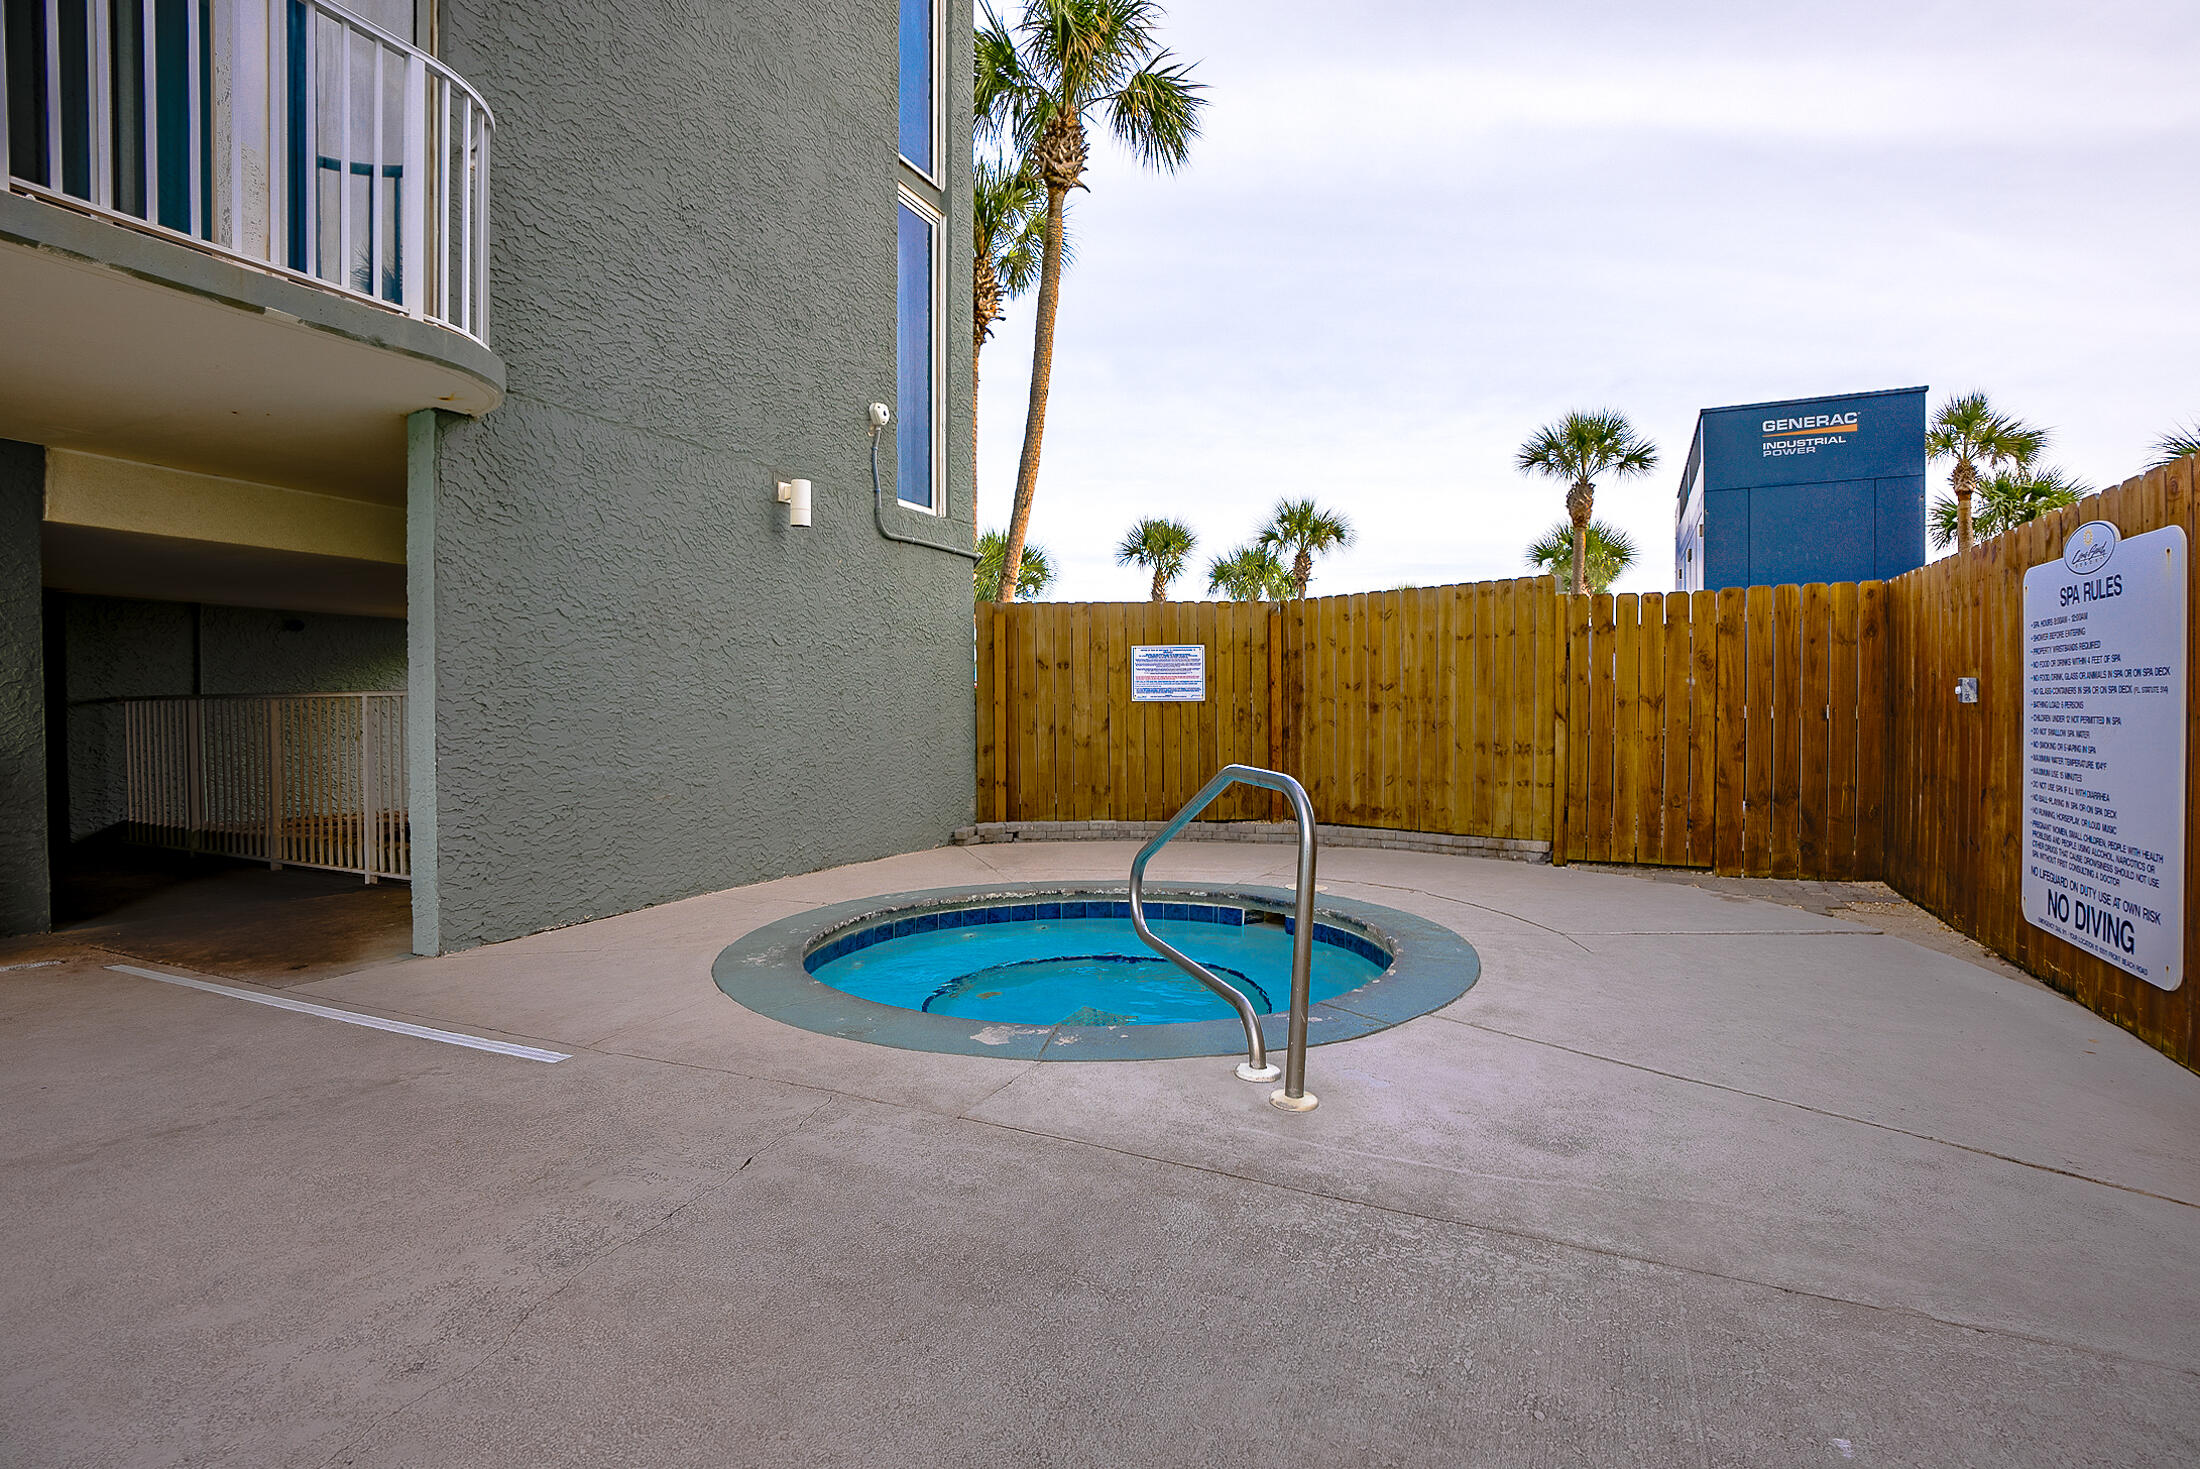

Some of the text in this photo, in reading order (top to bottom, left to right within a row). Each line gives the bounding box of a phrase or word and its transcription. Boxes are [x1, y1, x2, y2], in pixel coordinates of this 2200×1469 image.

[1762, 411, 1858, 432] GENERAC
[1762, 435, 1847, 450] INDUSTRIAL
[1763, 446, 1816, 458] POWER
[2060, 574, 2123, 607] SPA RULES
[2049, 630, 2064, 640] BEFORE
[2065, 627, 2086, 638] ENTERING
[2079, 640, 2101, 650] REQUIRED
[2033, 660, 2039, 669] NO
[2039, 659, 2050, 668] FOOD
[2072, 656, 2087, 666] WITHIN
[2092, 655, 2103, 664] FEET
[2104, 655, 2111, 664] OF
[2111, 653, 2121, 663] SPA
[2033, 673, 2039, 682] NO
[2064, 672, 2078, 681] GLASS
[2079, 671, 2086, 680] OR
[2086, 670, 2107, 680] ANIMALS
[2113, 668, 2123, 679] SPA
[2124, 668, 2133, 678] OR
[2133, 668, 2142, 677] ON
[2142, 667, 2154, 677] SPA
[2155, 665, 2171, 677] DECK
[2033, 687, 2039, 695] NO
[2039, 687, 2051, 695] GLASS
[2051, 686, 2077, 695] CONTAINERS
[2082, 686, 2091, 695] SPA
[2092, 686, 2099, 695] OR
[2099, 686, 2107, 695] ON
[2107, 685, 2117, 694] SPA
[2118, 685, 2133, 694] DECK
[2064, 700, 2084, 709] PERSONS
[2033, 714, 2051, 723] CHILDREN
[2052, 714, 2065, 723] UNDER
[2071, 715, 2080, 724] NOT
[2080, 715, 2104, 725] PERMITTED
[2111, 716, 2122, 726] SPA
[2033, 727, 2090, 740] DO NOT SWALLOW SPA WATER
[2033, 741, 2039, 749] NO
[2088, 745, 2097, 755] SPA
[2051, 756, 2064, 765] WATER
[2064, 757, 2095, 769] TEMPERATURE
[2051, 769, 2060, 779] USE
[2064, 772, 2083, 783] MINUTES
[2039, 781, 2047, 791] NOT
[2047, 783, 2056, 792] USE
[2056, 784, 2064, 793] SPA
[2075, 787, 2087, 798] WITH
[2087, 790, 2110, 802] DIARRHEA
[2033, 793, 2039, 802] NO
[2070, 801, 2079, 810] SPA
[2079, 803, 2086, 812] OR
[2087, 804, 2094, 814] ON
[2094, 806, 2103, 816] SPA
[2103, 808, 2117, 820] DECK
[2033, 806, 2039, 815] NO
[2088, 819, 2101, 831] LOUD
[2101, 823, 2117, 835] MUSIC
[2032, 829, 2052, 843] PROBLEMS
[2052, 835, 2061, 846] AND
[2061, 838, 2078, 851] PEOPLE
[2078, 844, 2091, 855] USING
[2116, 854, 2146, 873] NARCOTICS
[2146, 863, 2156, 875] OR
[2069, 829, 2083, 842] SMALL
[2107, 839, 2127, 854] PEOPLE
[2127, 846, 2141, 858] WITH
[2142, 848, 2164, 865] HEALTH
[2032, 839, 2160, 889] OTHER DRUGS THAT CAUSE DROWSINESS SHOULD NOT USE
[2039, 851, 2057, 865] WITHOUT
[2057, 857, 2068, 870] FIRST
[2068, 862, 2095, 880] CONSULTING
[2100, 873, 2121, 888] DOCTOR
[2031, 865, 2161, 927] NO LIFEGUARD ON DUTY USE AT OWN RISK
[2047, 888, 2135, 956] NO DIVING
